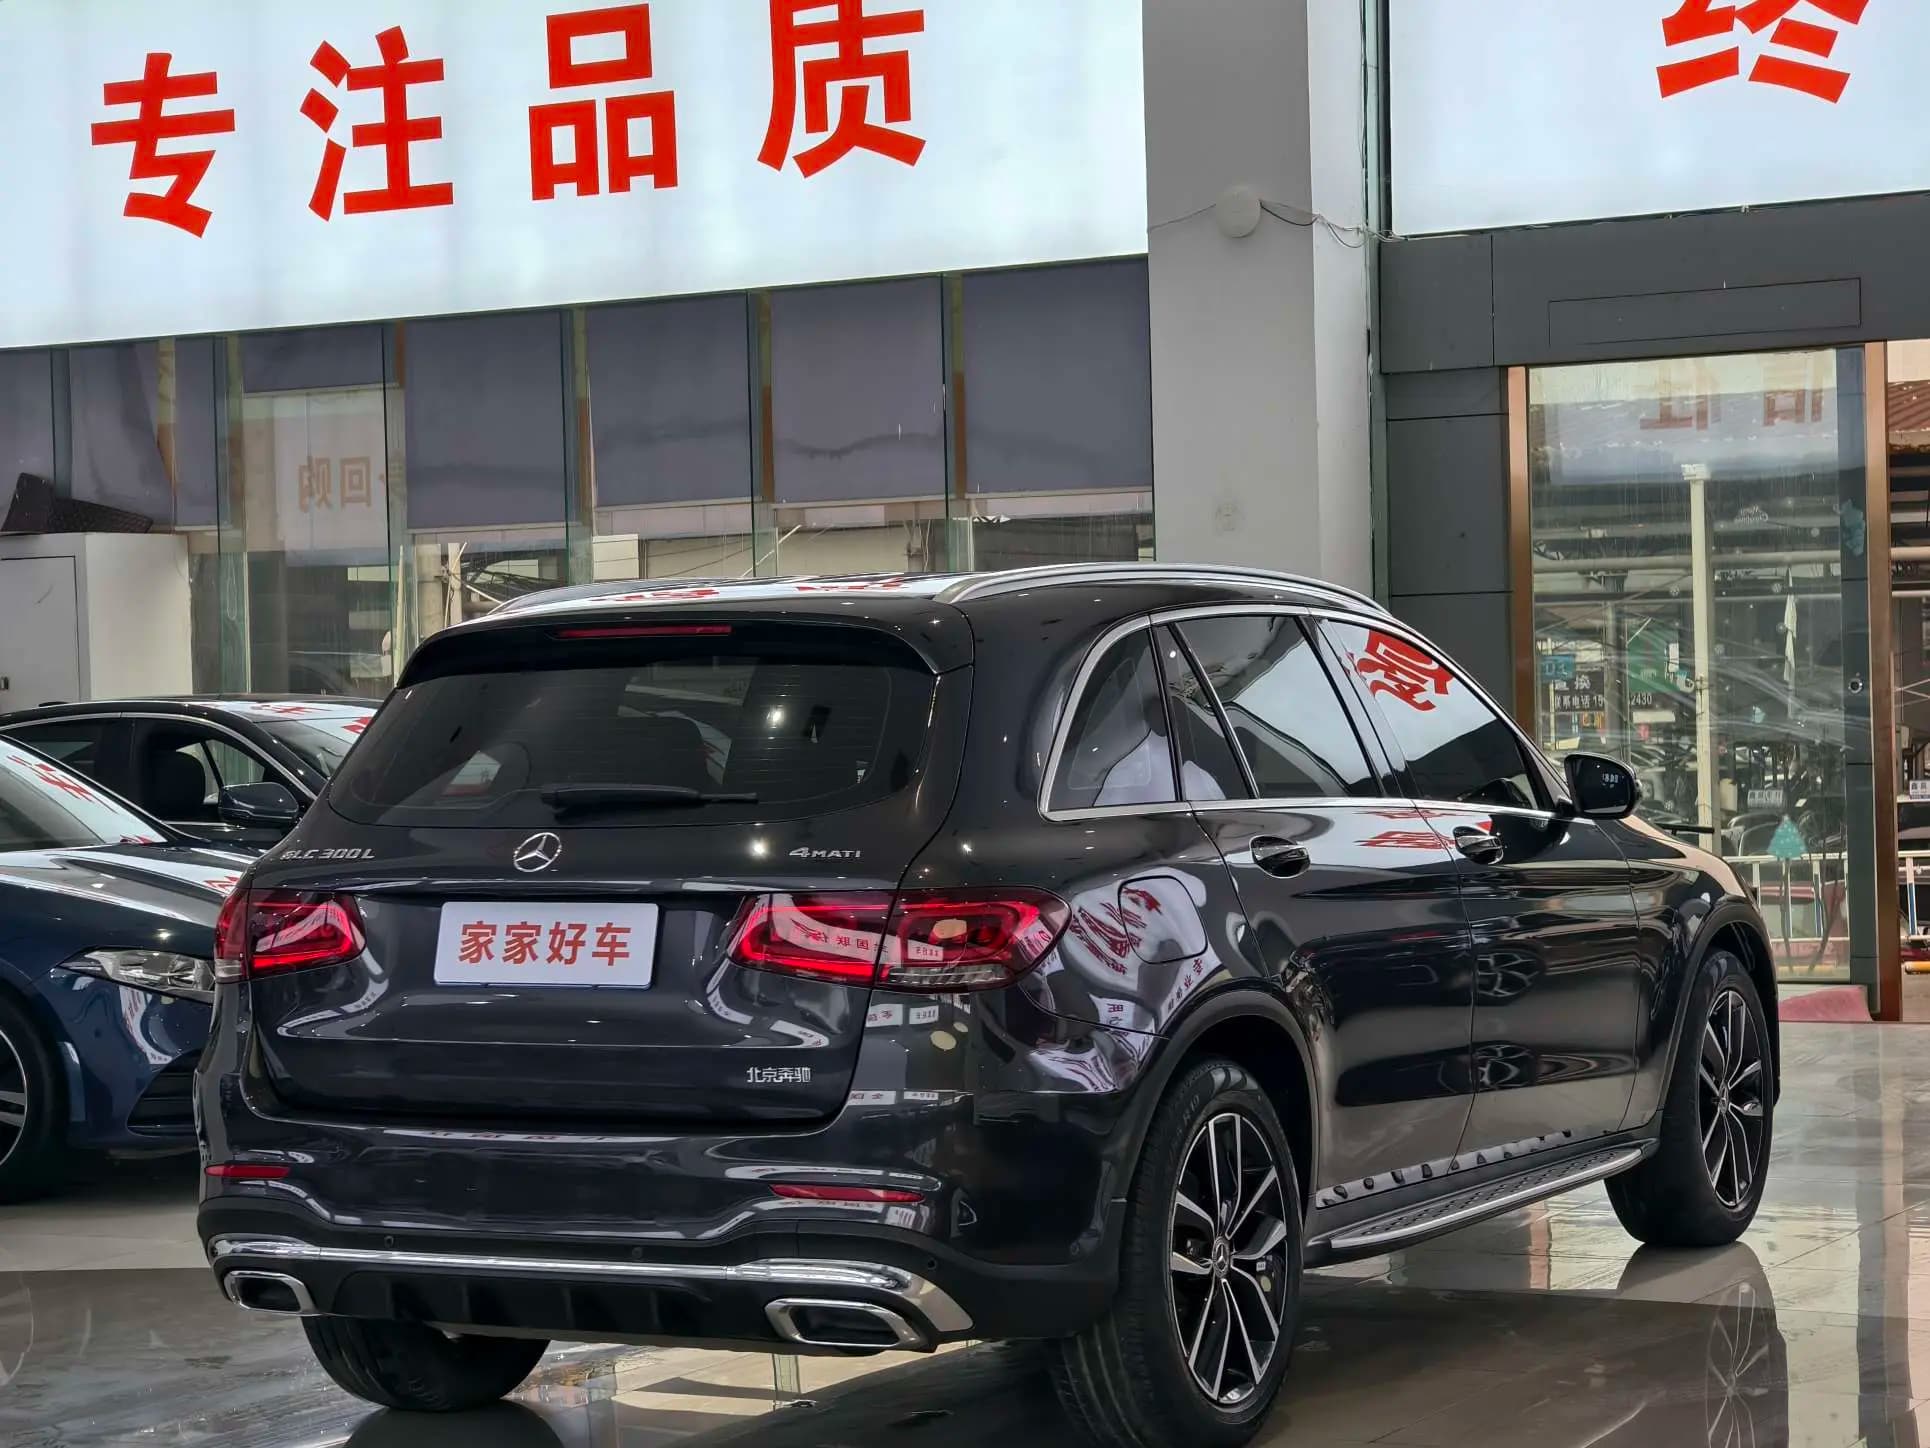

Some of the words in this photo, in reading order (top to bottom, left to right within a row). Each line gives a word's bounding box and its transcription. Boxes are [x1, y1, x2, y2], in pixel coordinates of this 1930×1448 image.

[91, 0, 926, 237] 专注品质
[458, 920, 632, 967] 家家好车
[746, 1066, 811, 1083] 北京奔驰
